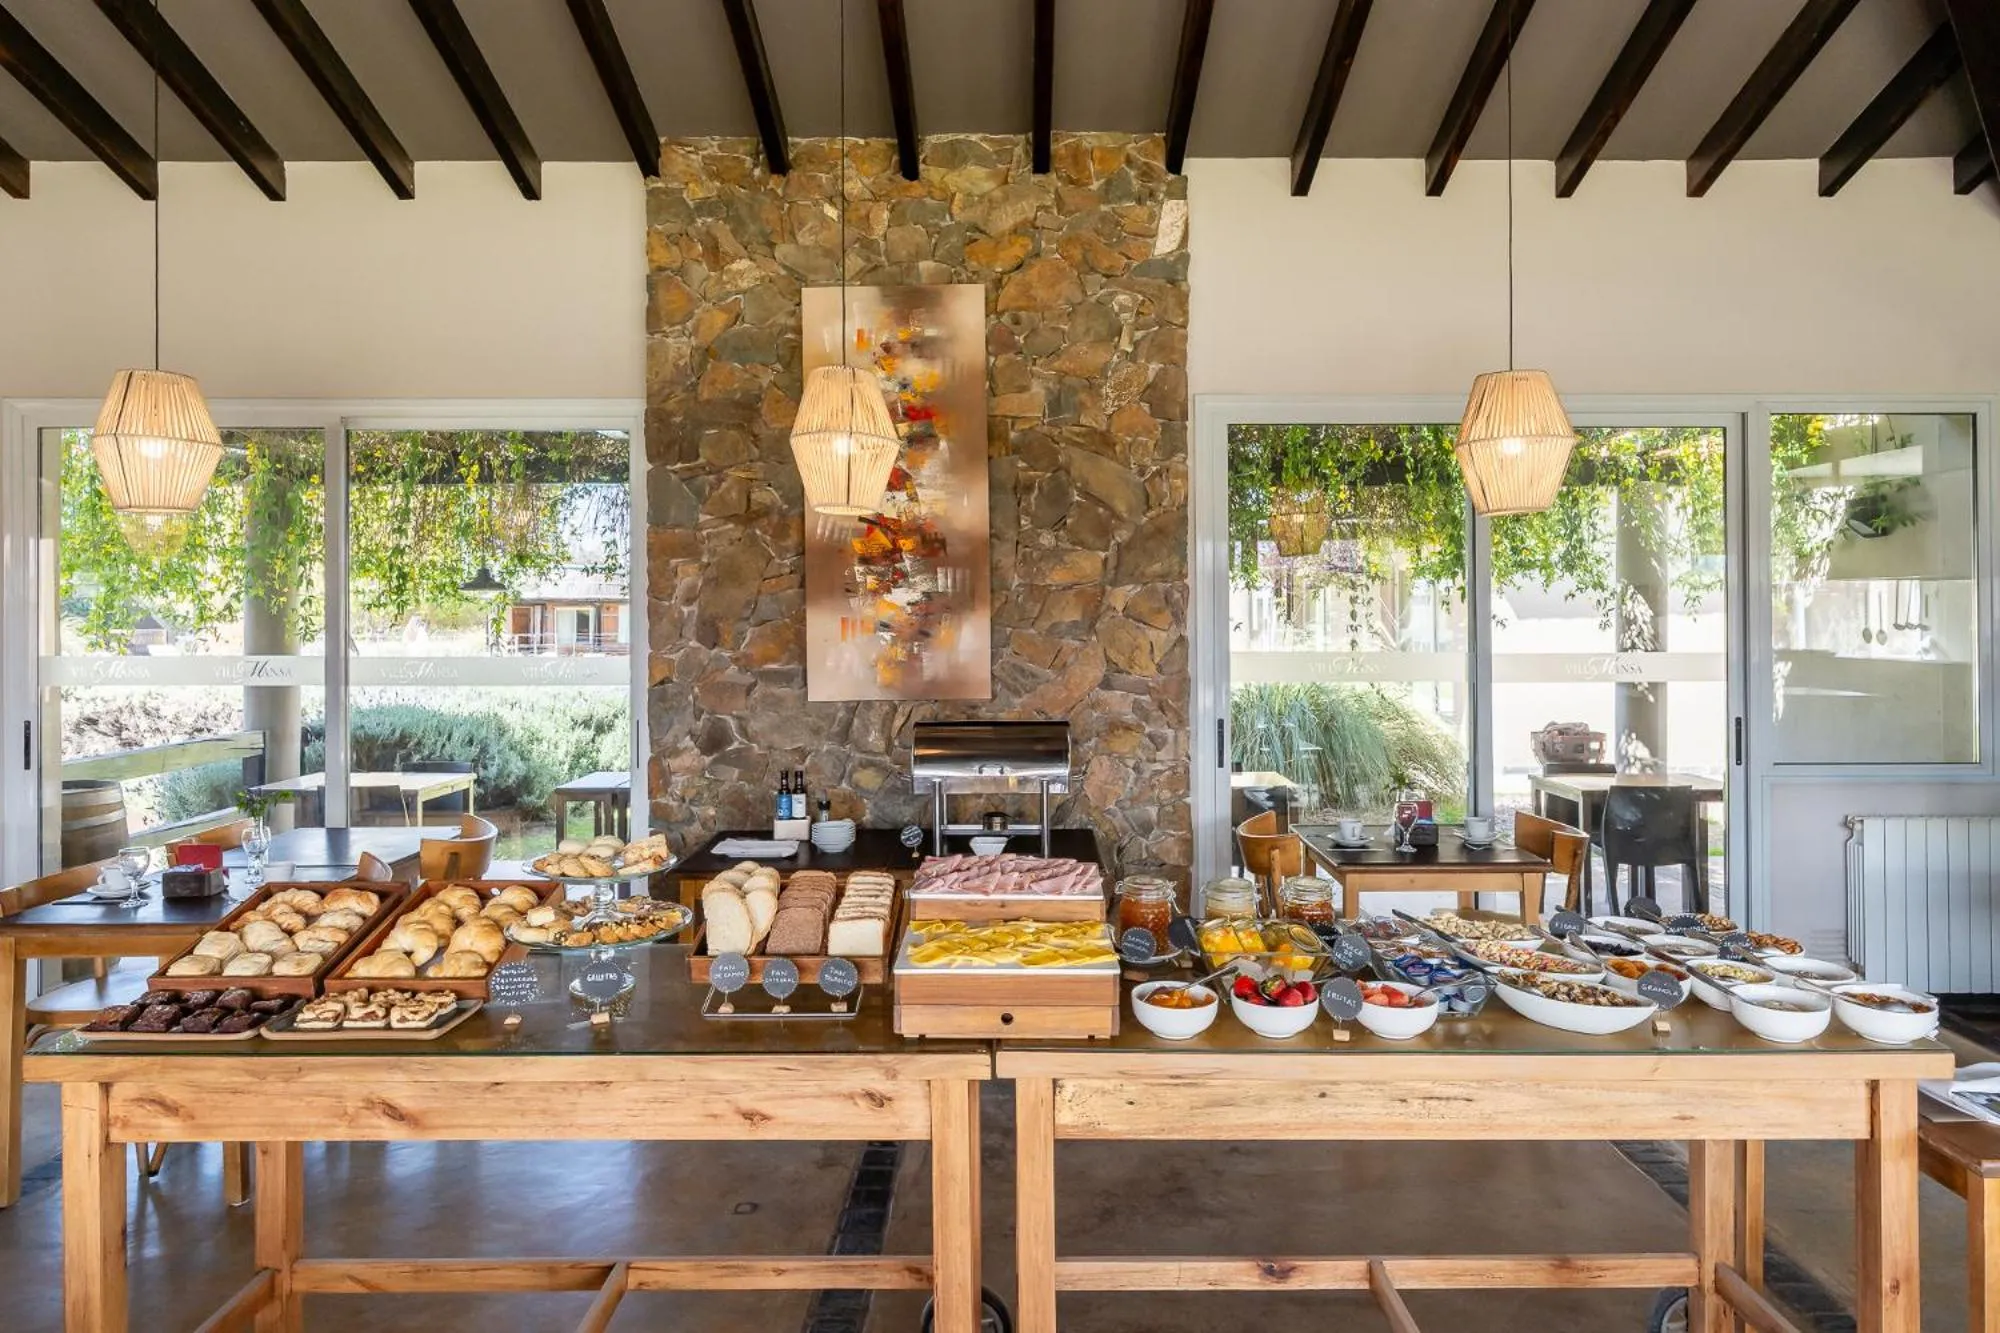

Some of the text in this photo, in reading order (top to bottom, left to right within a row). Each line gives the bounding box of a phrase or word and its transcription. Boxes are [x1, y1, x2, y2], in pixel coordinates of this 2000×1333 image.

[719, 963, 737, 971] PAN
[771, 969, 788, 977] PAN
[1640, 983, 1679, 996] GRANOLA
